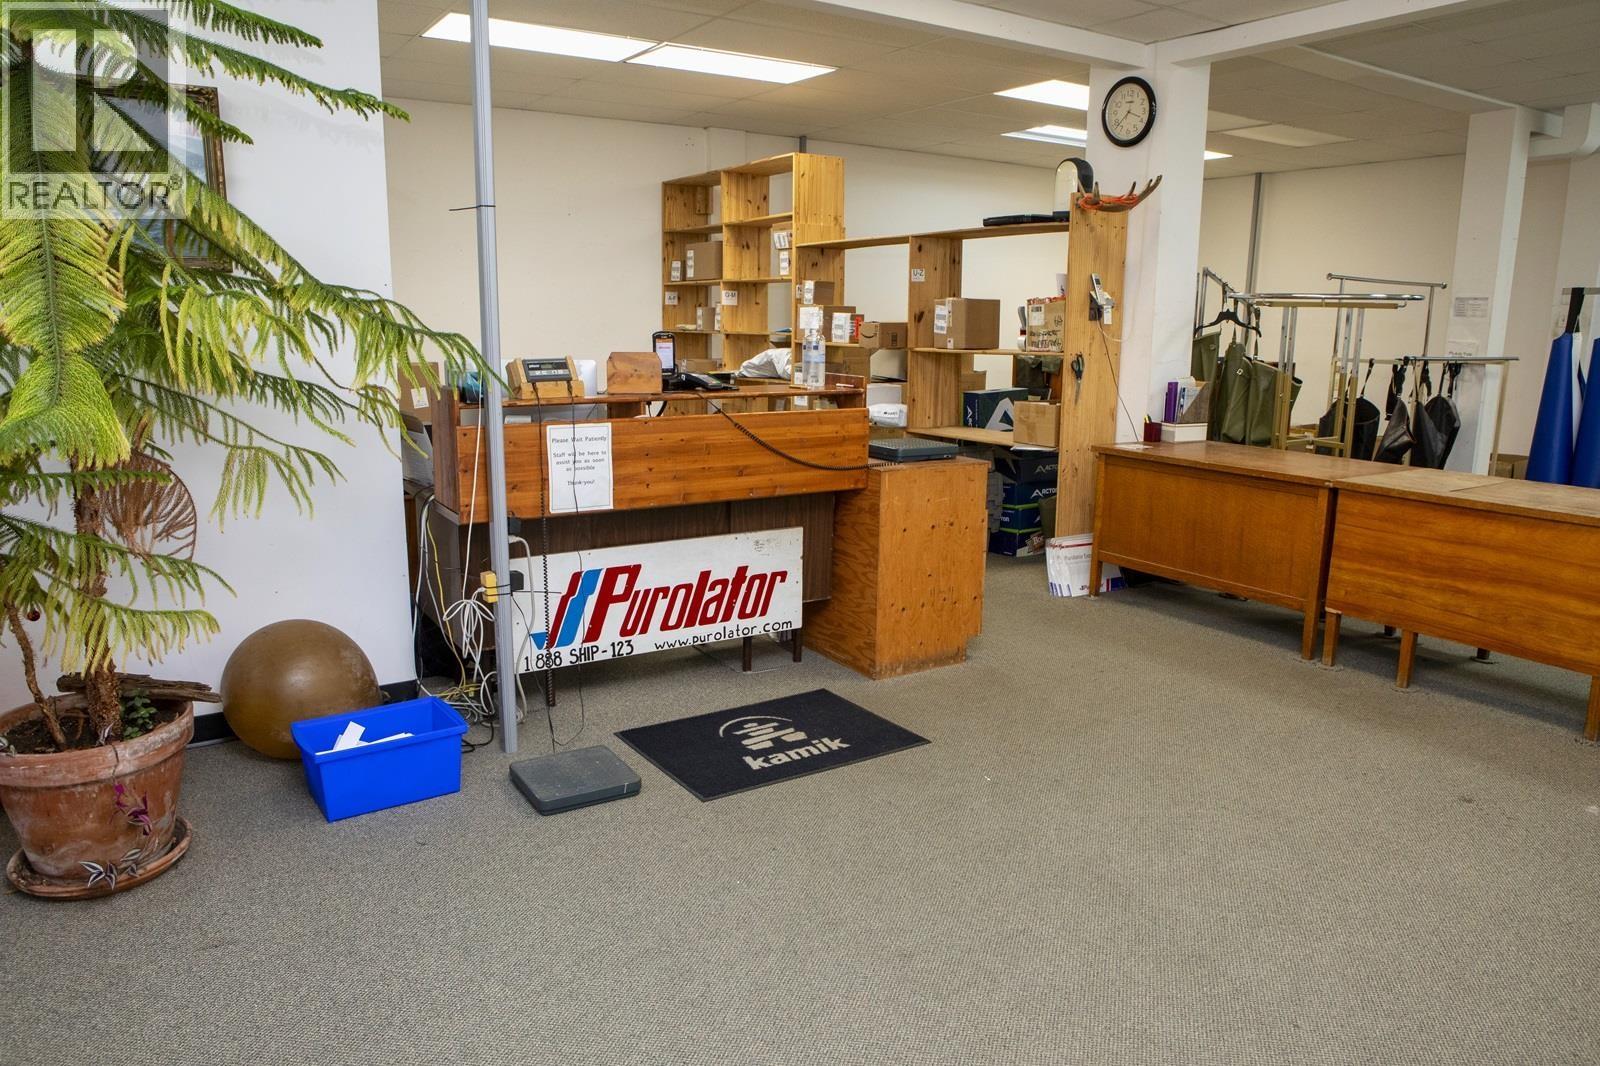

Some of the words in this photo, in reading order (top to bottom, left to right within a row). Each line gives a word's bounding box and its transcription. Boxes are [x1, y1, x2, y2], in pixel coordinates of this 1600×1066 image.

[583, 564, 788, 643] Purolator
[654, 619, 793, 650] www.purolator.com
[742, 738, 851, 770] kamik
